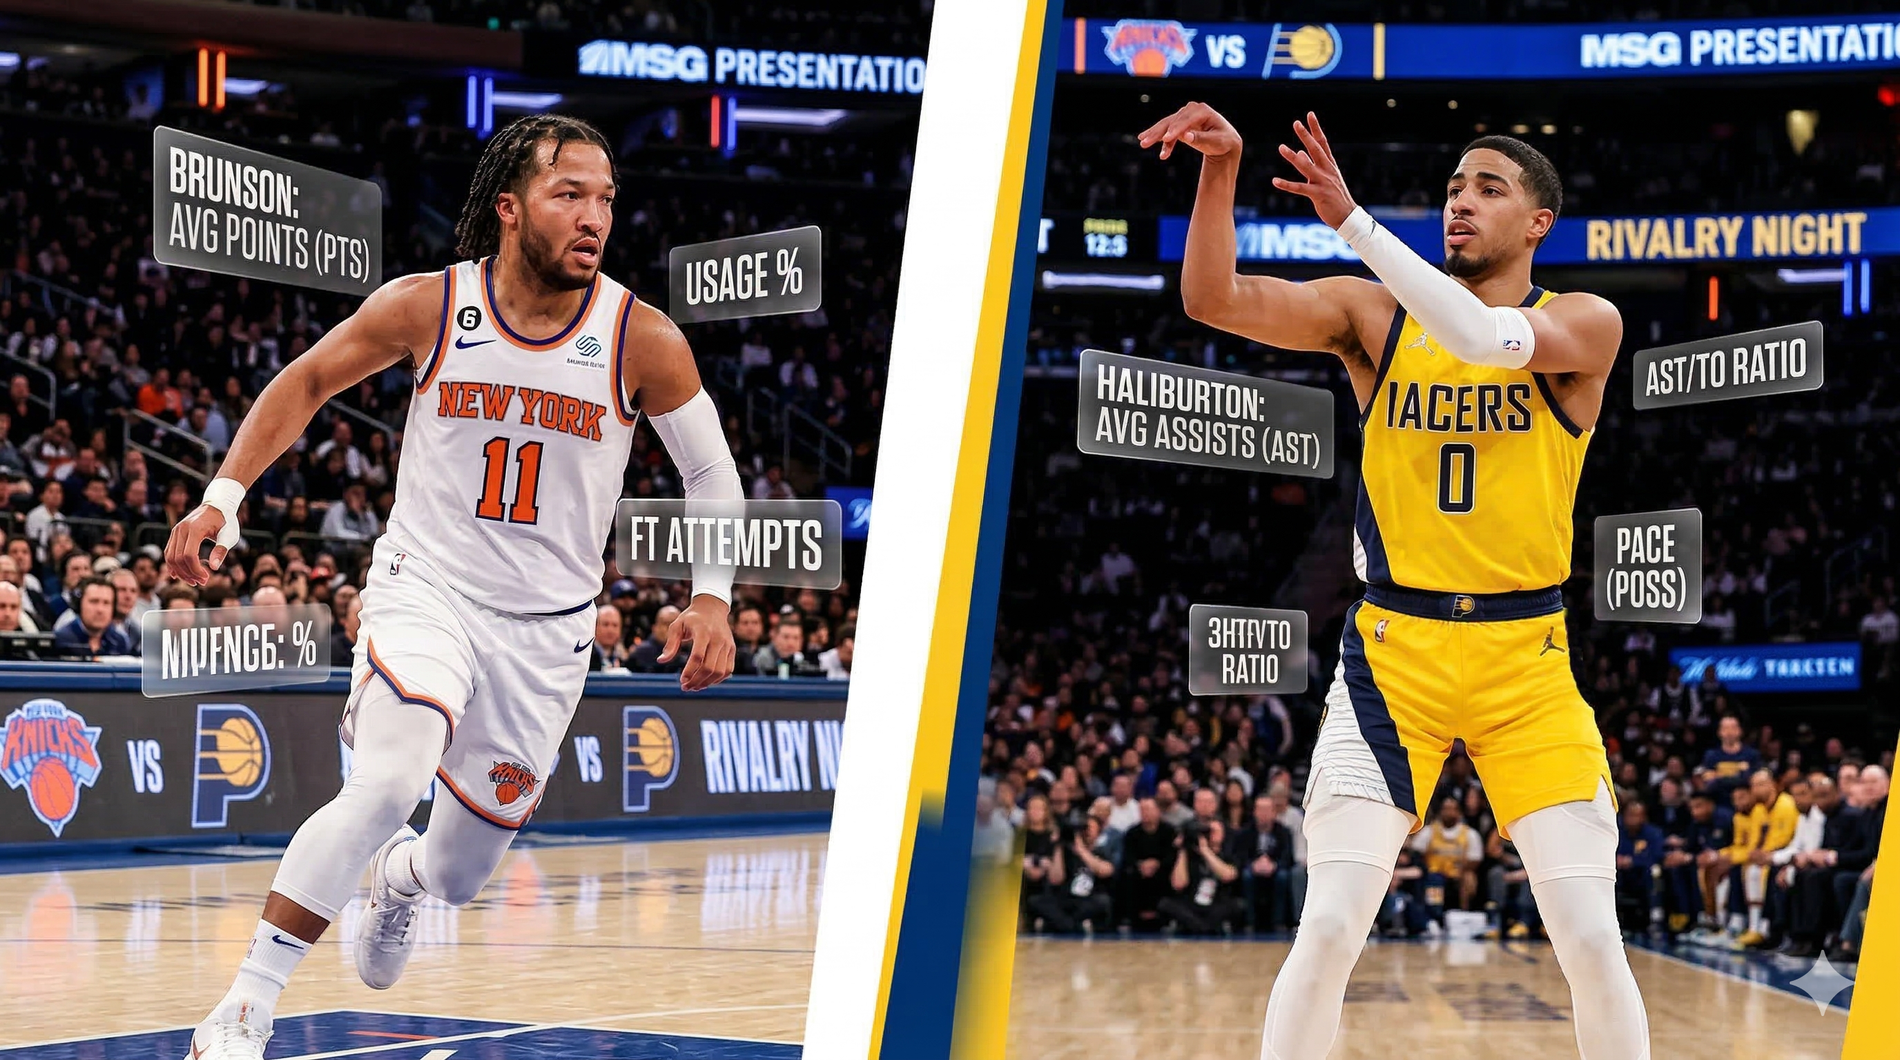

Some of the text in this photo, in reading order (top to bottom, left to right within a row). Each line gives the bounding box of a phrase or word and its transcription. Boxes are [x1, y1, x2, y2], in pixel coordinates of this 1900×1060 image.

[611, 41, 925, 93] MSG PRESENTATIO
[1205, 34, 1246, 69] VS
[1581, 32, 1681, 67] MSG
[1586, 213, 1867, 260] RIVALRY NIGHT
[463, 309, 477, 328] 6
[438, 381, 607, 442] NEW YORK
[475, 436, 544, 525] 11
[1437, 442, 1476, 514] 0
[1, 715, 98, 769] KNICKS
[126, 739, 164, 794] VS
[574, 736, 604, 783] VS
[700, 720, 812, 793] RIVALRY
